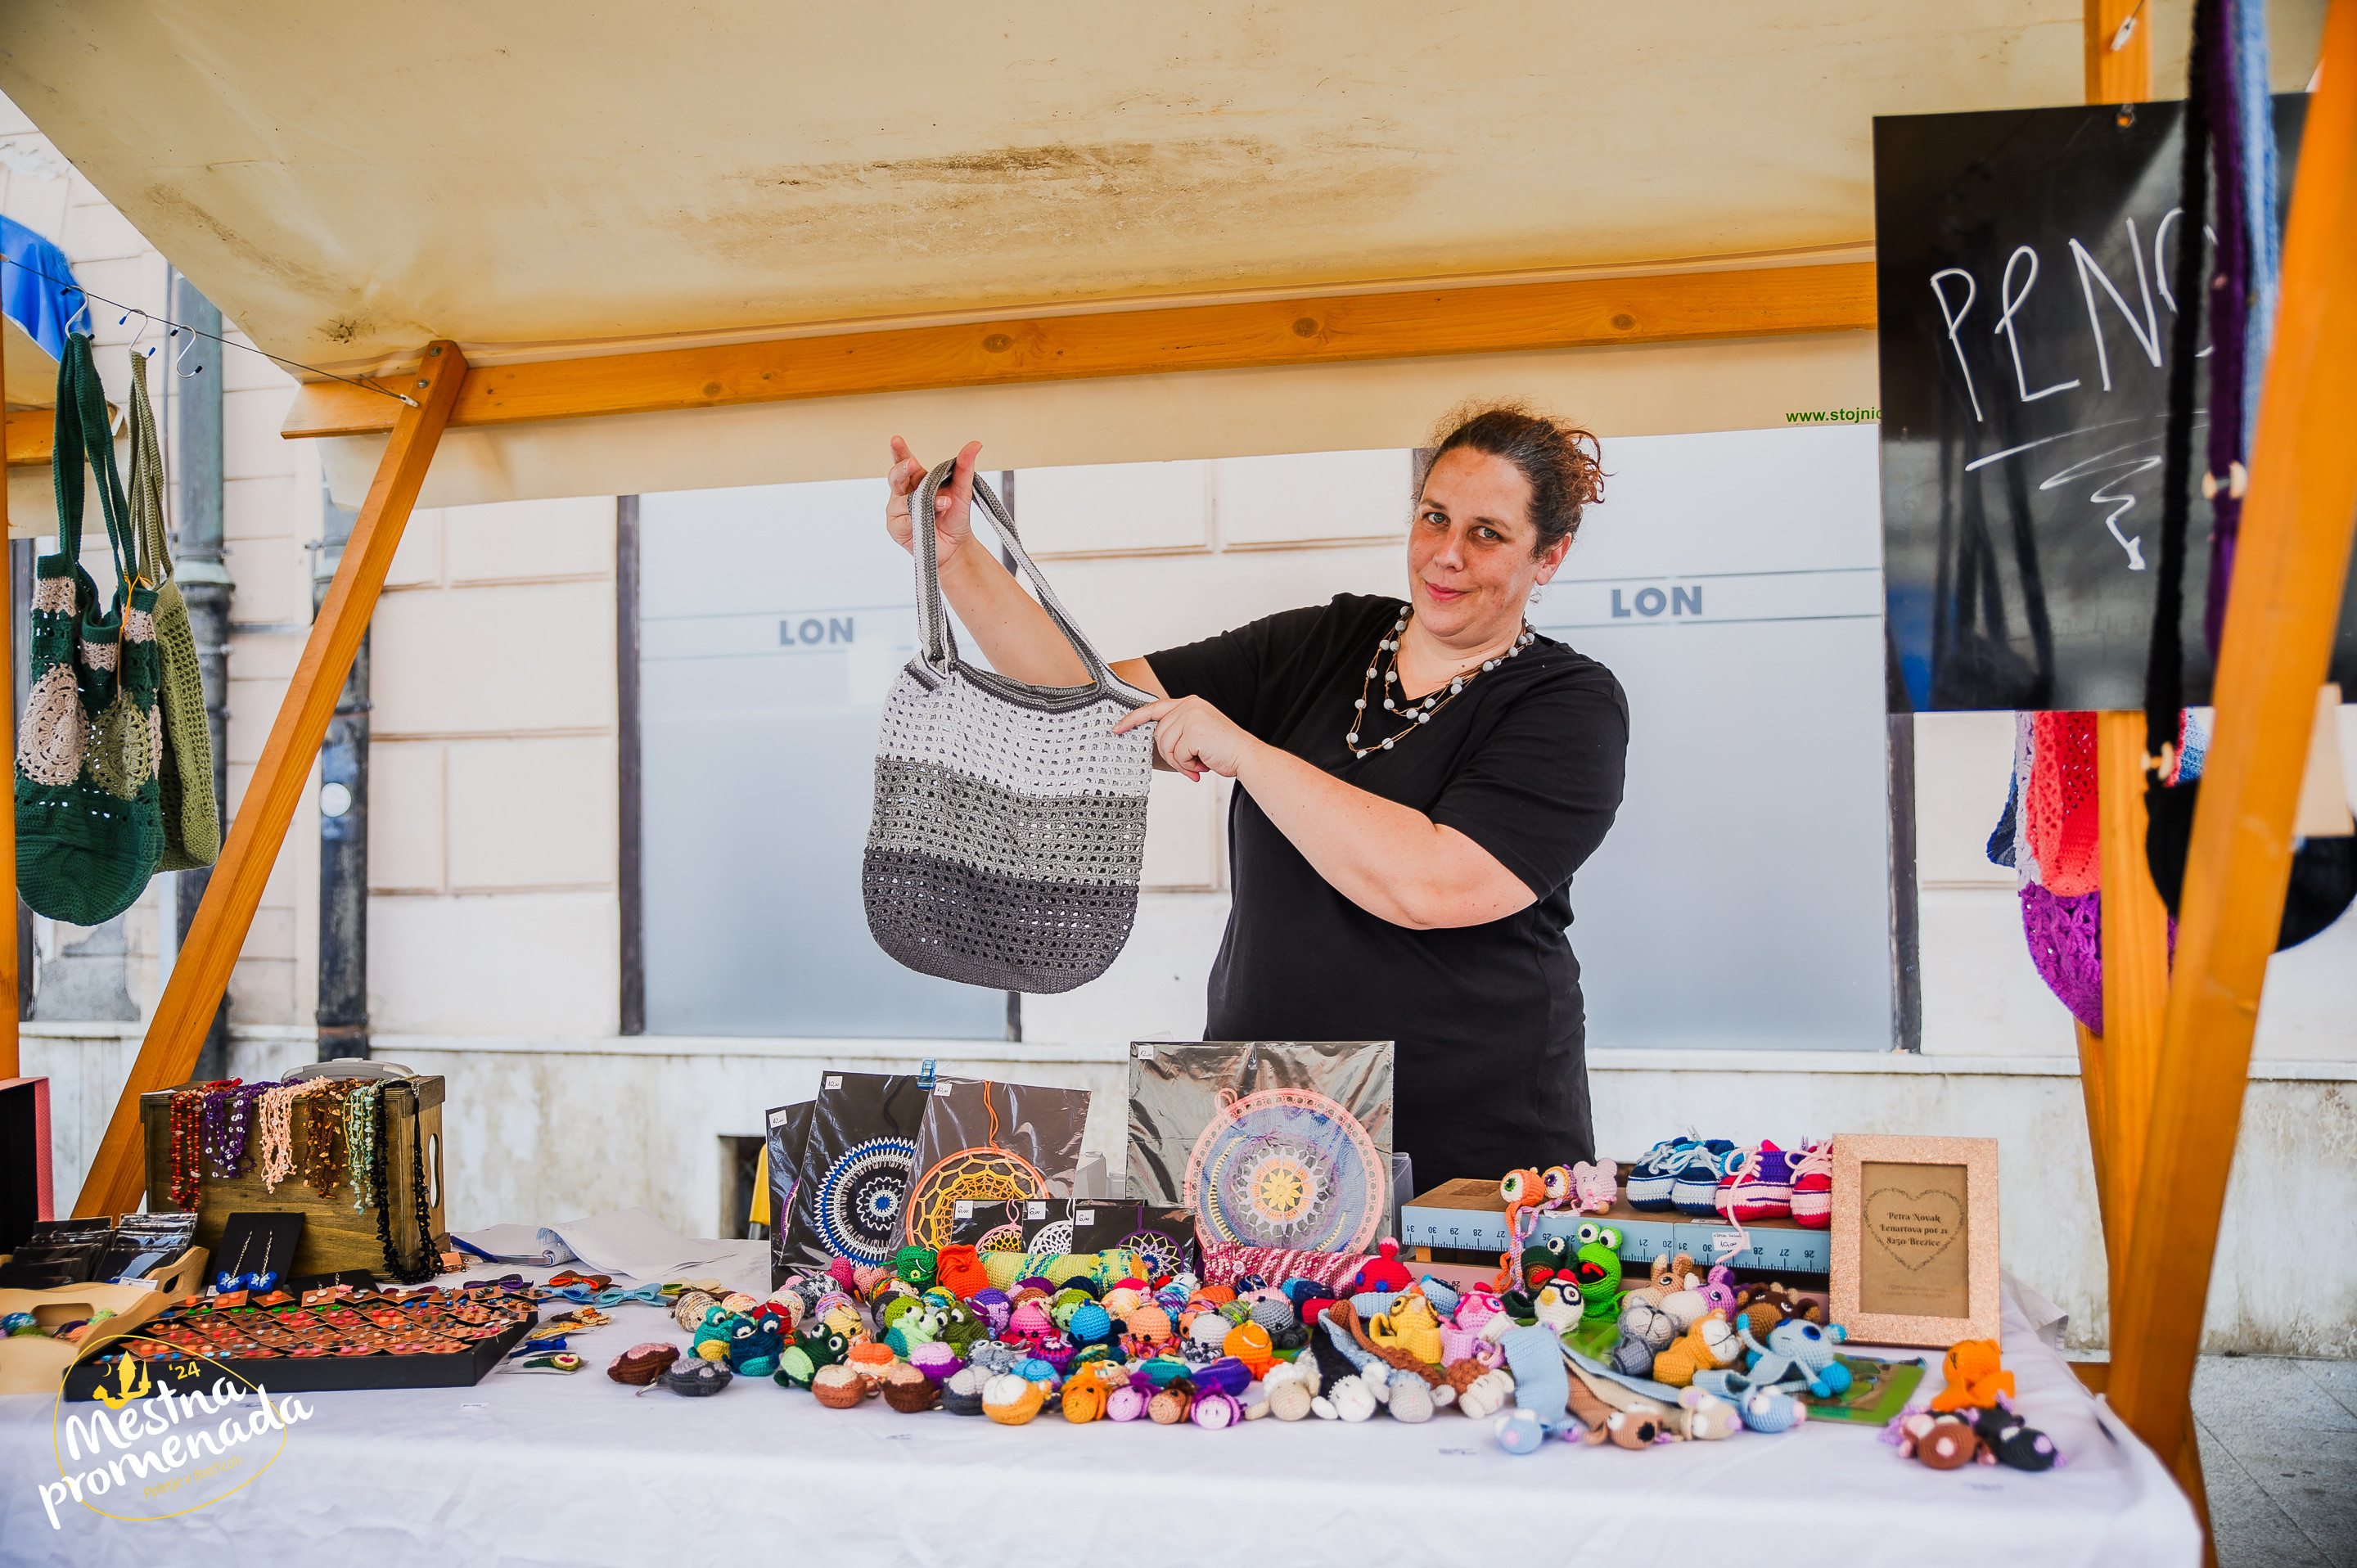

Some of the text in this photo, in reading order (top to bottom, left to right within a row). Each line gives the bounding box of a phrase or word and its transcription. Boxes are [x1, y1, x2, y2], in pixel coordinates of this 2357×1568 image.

[1611, 585, 1702, 618] LON
[780, 617, 853, 646] LON
[1887, 1212, 1941, 1223] Petra Novak
[1406, 1224, 1415, 1232] 31
[1427, 1226, 1437, 1234] 30
[1473, 1228, 1482, 1237] 28
[1879, 1223, 1922, 1233] Lenartova
[1497, 1230, 1506, 1238] 27
[1662, 1240, 1672, 1248] 20
[1886, 1237, 1906, 1246] 8250
[1679, 1242, 1814, 1258] 26 27 28 30 31
